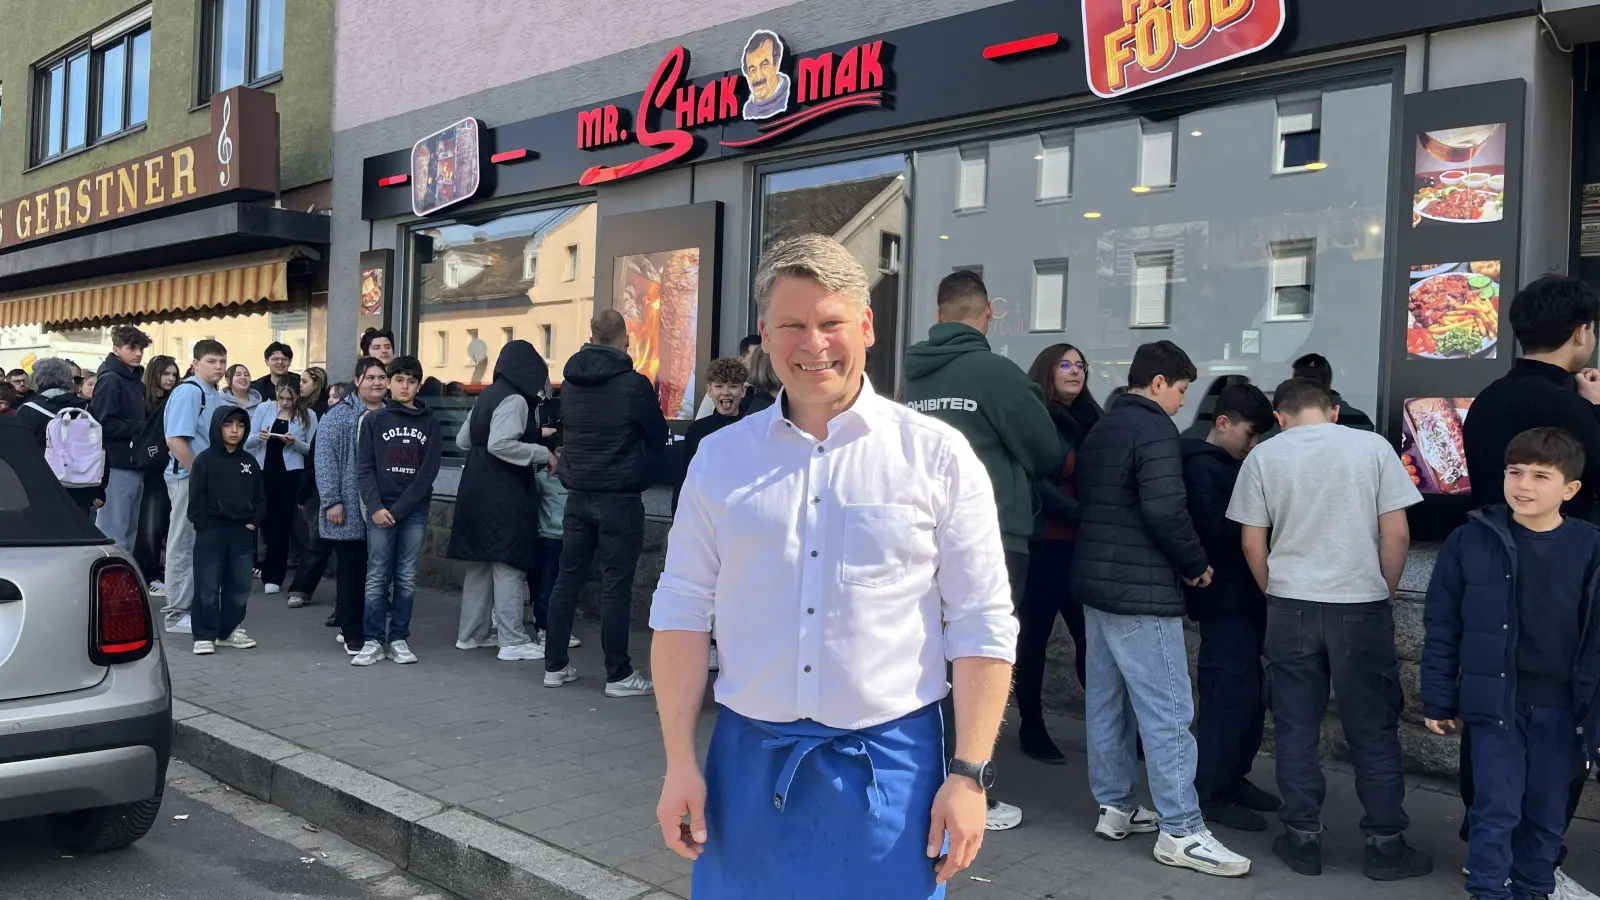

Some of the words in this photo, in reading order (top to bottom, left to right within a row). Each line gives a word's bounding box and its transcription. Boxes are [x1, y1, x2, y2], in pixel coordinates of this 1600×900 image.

[577, 105, 627, 149] MR.
[797, 40, 884, 102] MAK
[16, 146, 197, 239] GERSTNER
[905, 397, 978, 412] OHIBITED
[382, 427, 427, 445] COLLEGE
